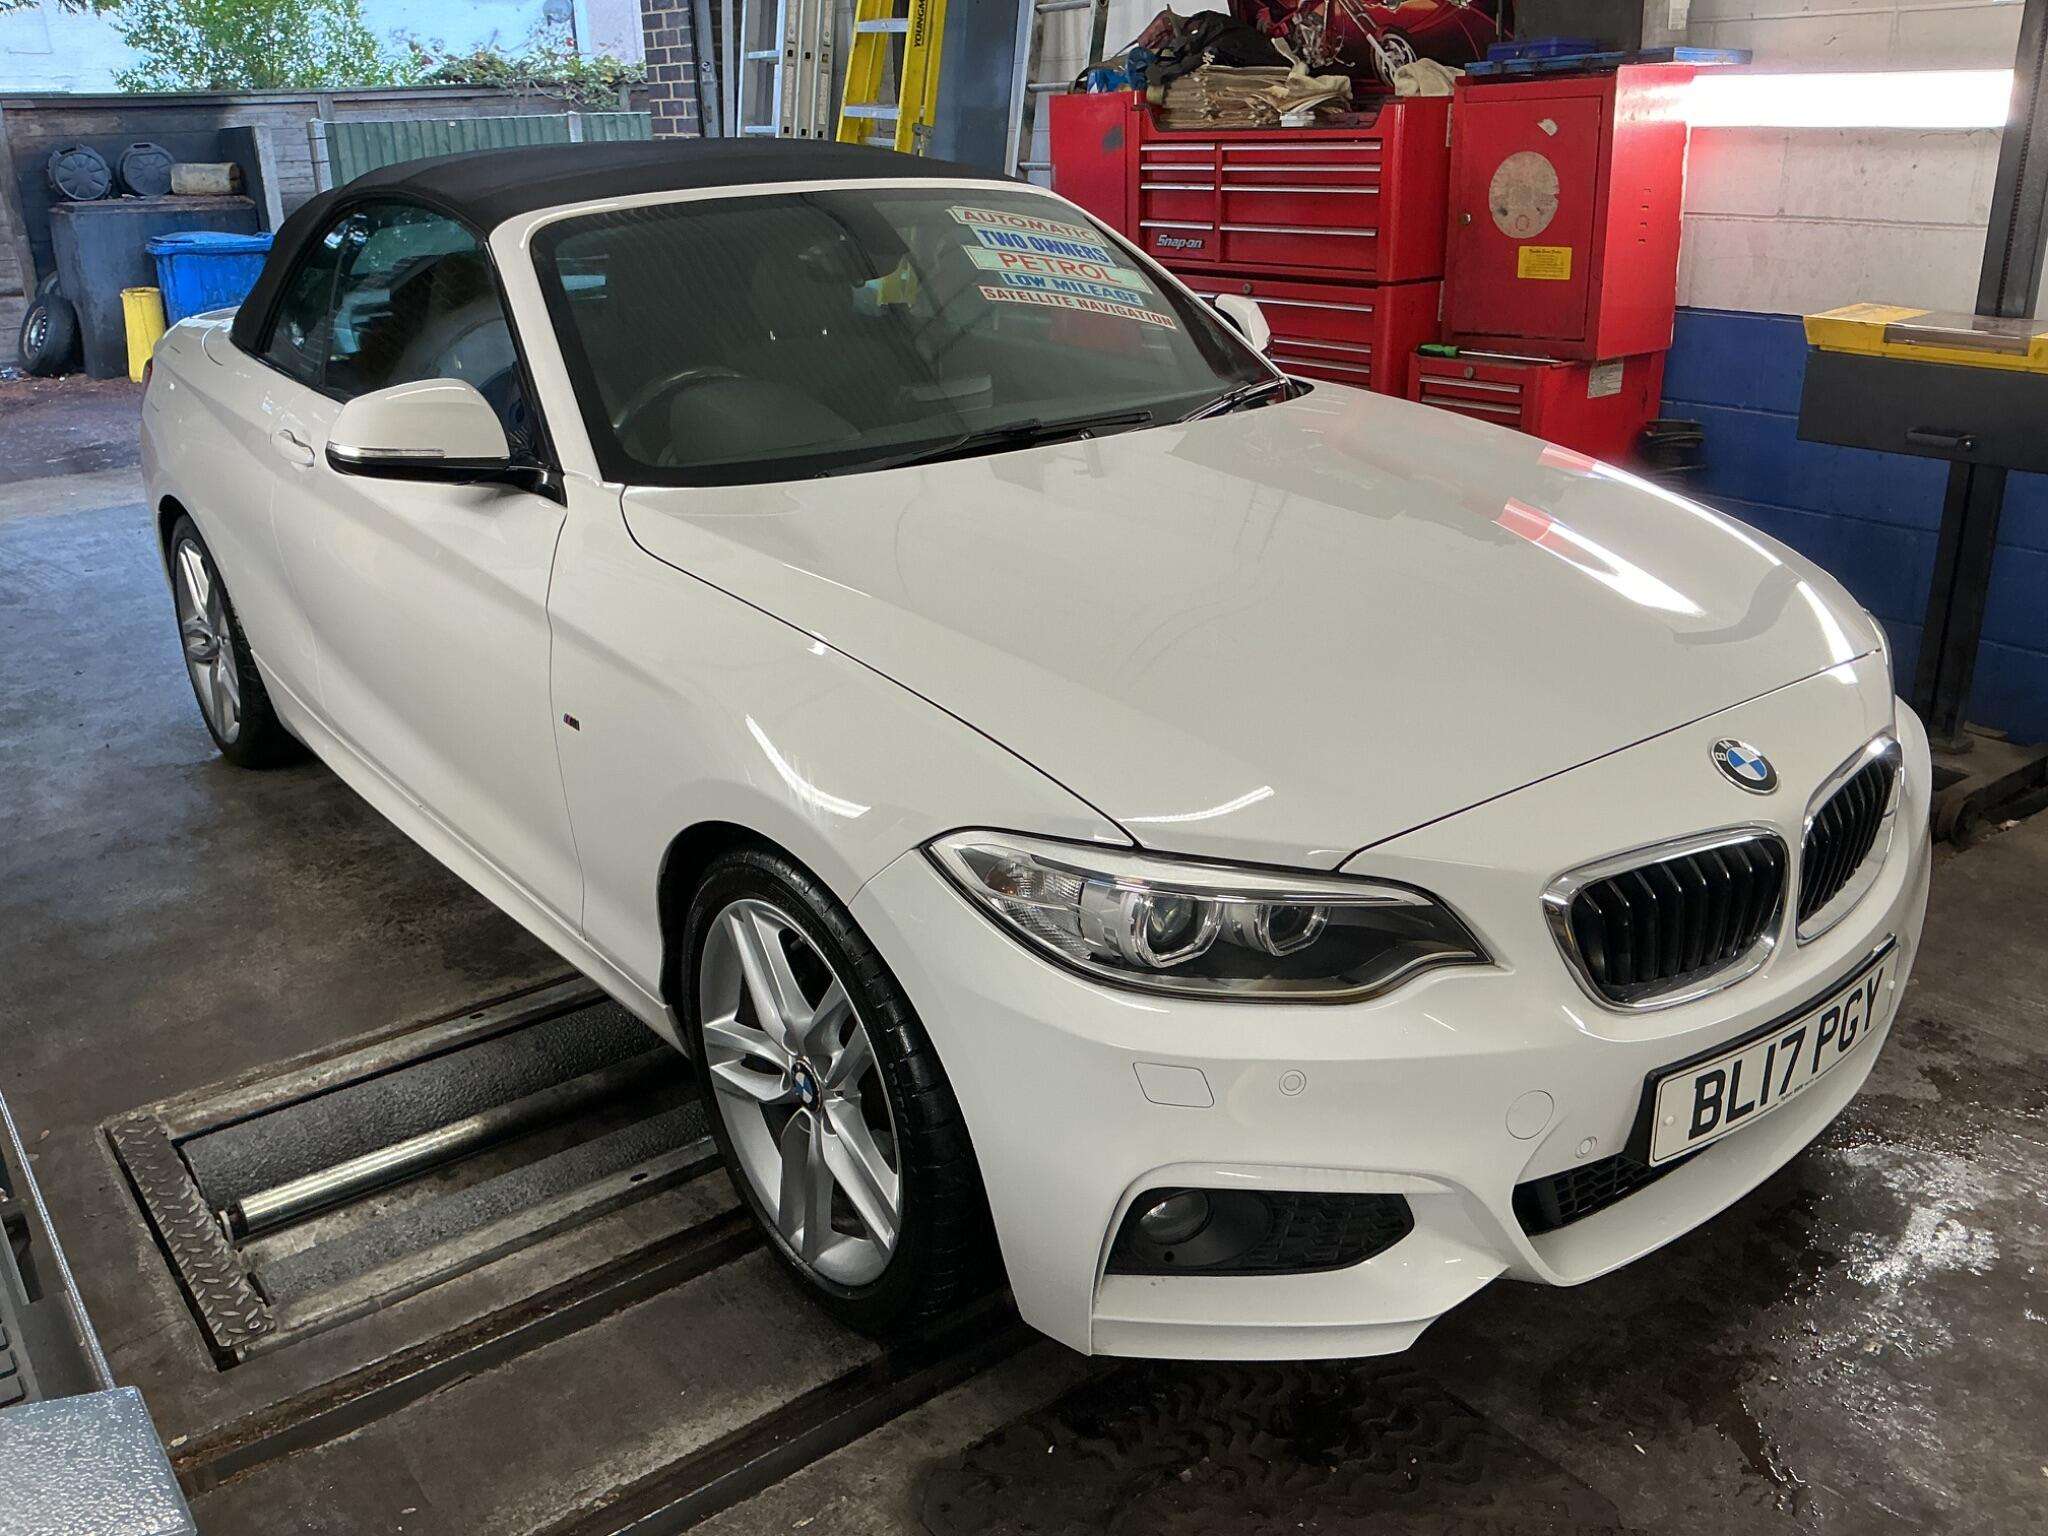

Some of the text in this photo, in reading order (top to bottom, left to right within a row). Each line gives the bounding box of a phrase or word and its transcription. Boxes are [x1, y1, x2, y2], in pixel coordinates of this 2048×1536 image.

[963, 211, 1096, 241] AUTOMATIC
[977, 229, 1110, 263] TWO OWNERS
[1156, 234, 1203, 250] Snap-on
[997, 252, 1123, 283] PETROL
[1003, 273, 1140, 304] LOW MILEAGE
[983, 288, 1173, 326] SATELLITE NAVIGATION
[1688, 967, 1885, 1141] BL17 PGY
